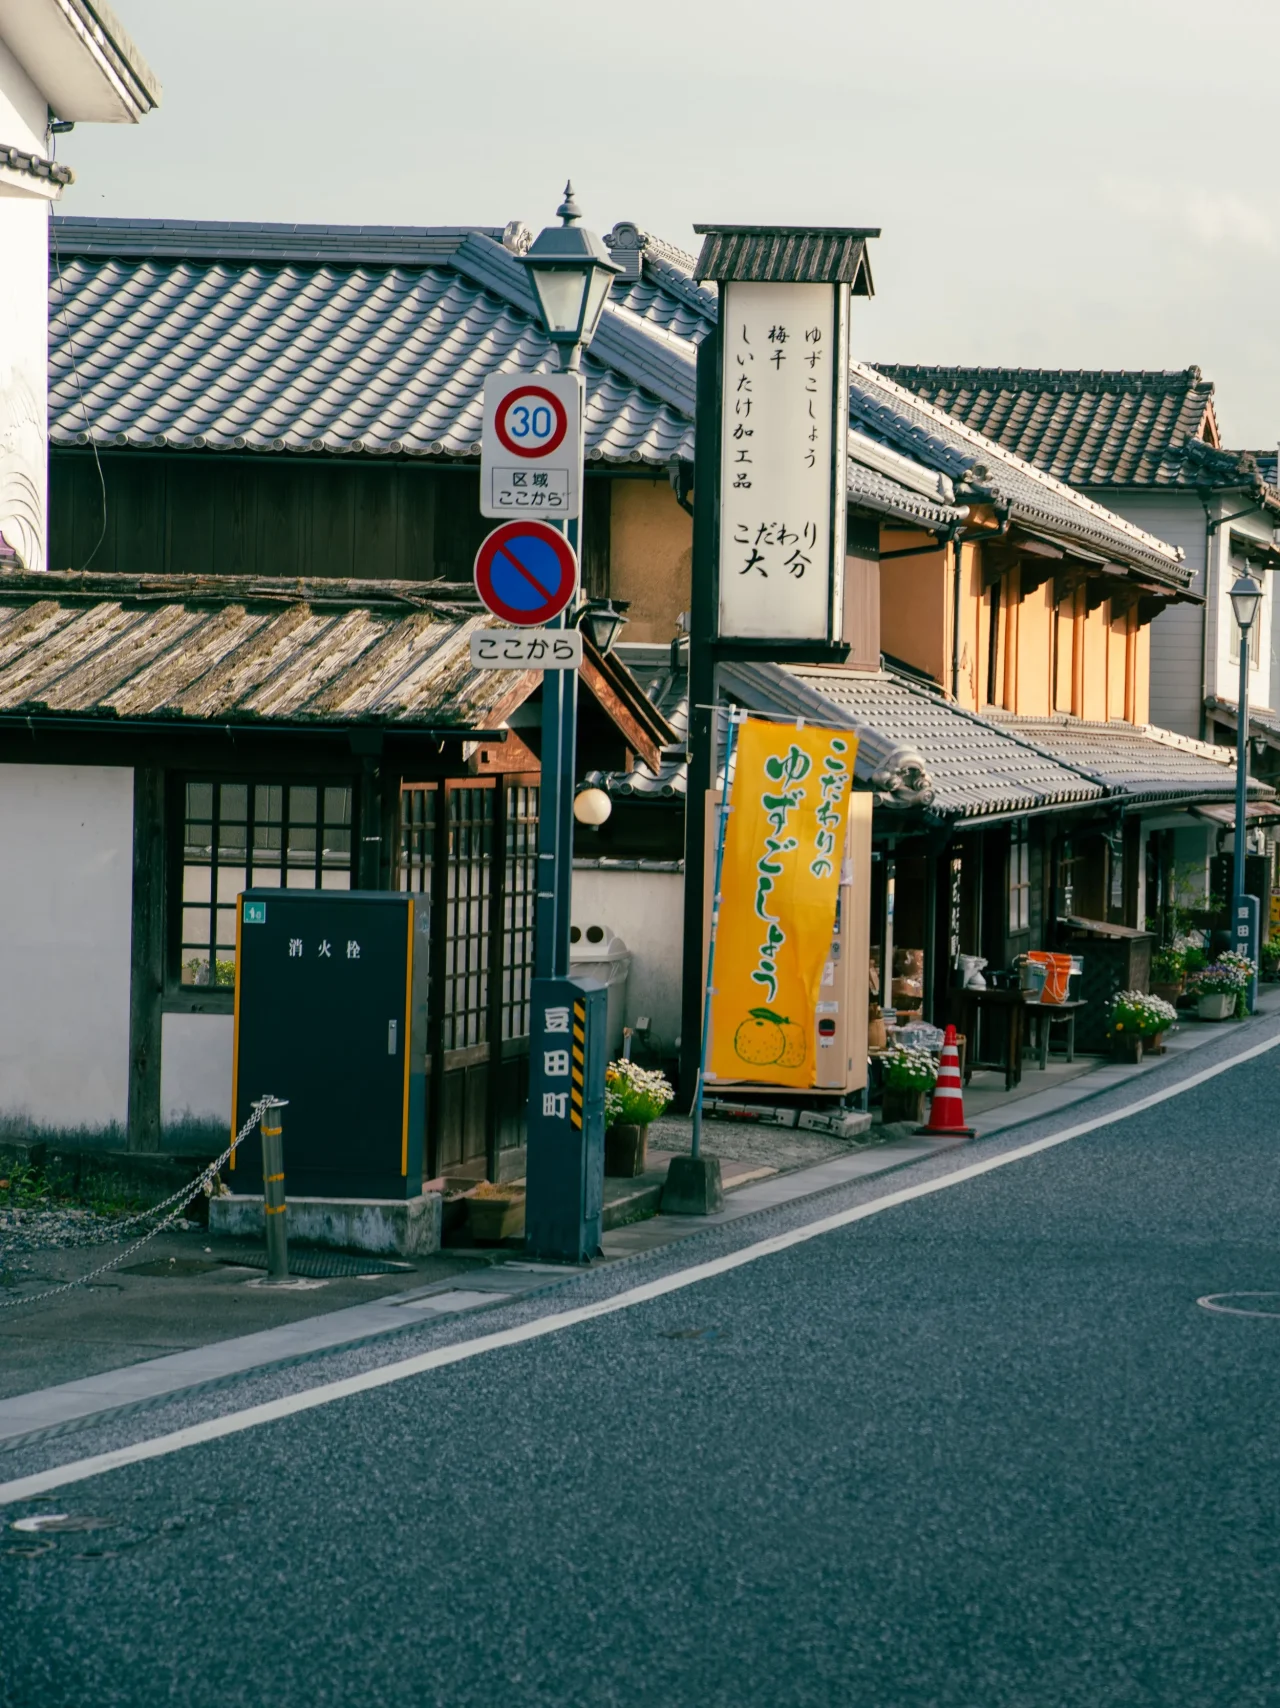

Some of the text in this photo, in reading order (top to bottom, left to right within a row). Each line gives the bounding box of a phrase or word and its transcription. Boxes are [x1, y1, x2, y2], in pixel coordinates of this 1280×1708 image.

[768, 325, 790, 371] 梅干
[733, 323, 754, 489] しいたけ加工品
[804, 326, 823, 469] ゆずこしょう
[511, 406, 552, 438] 30
[512, 472, 549, 488] 区域
[499, 491, 563, 507] ここから
[734, 520, 817, 550] こだわり
[738, 548, 812, 579] 大分
[478, 639, 574, 660] ここから
[810, 739, 848, 878] こだわりの
[750, 743, 813, 1005] ゆずごしょう
[289, 938, 361, 959] 消火栓
[542, 1006, 570, 1119] 豆田町
